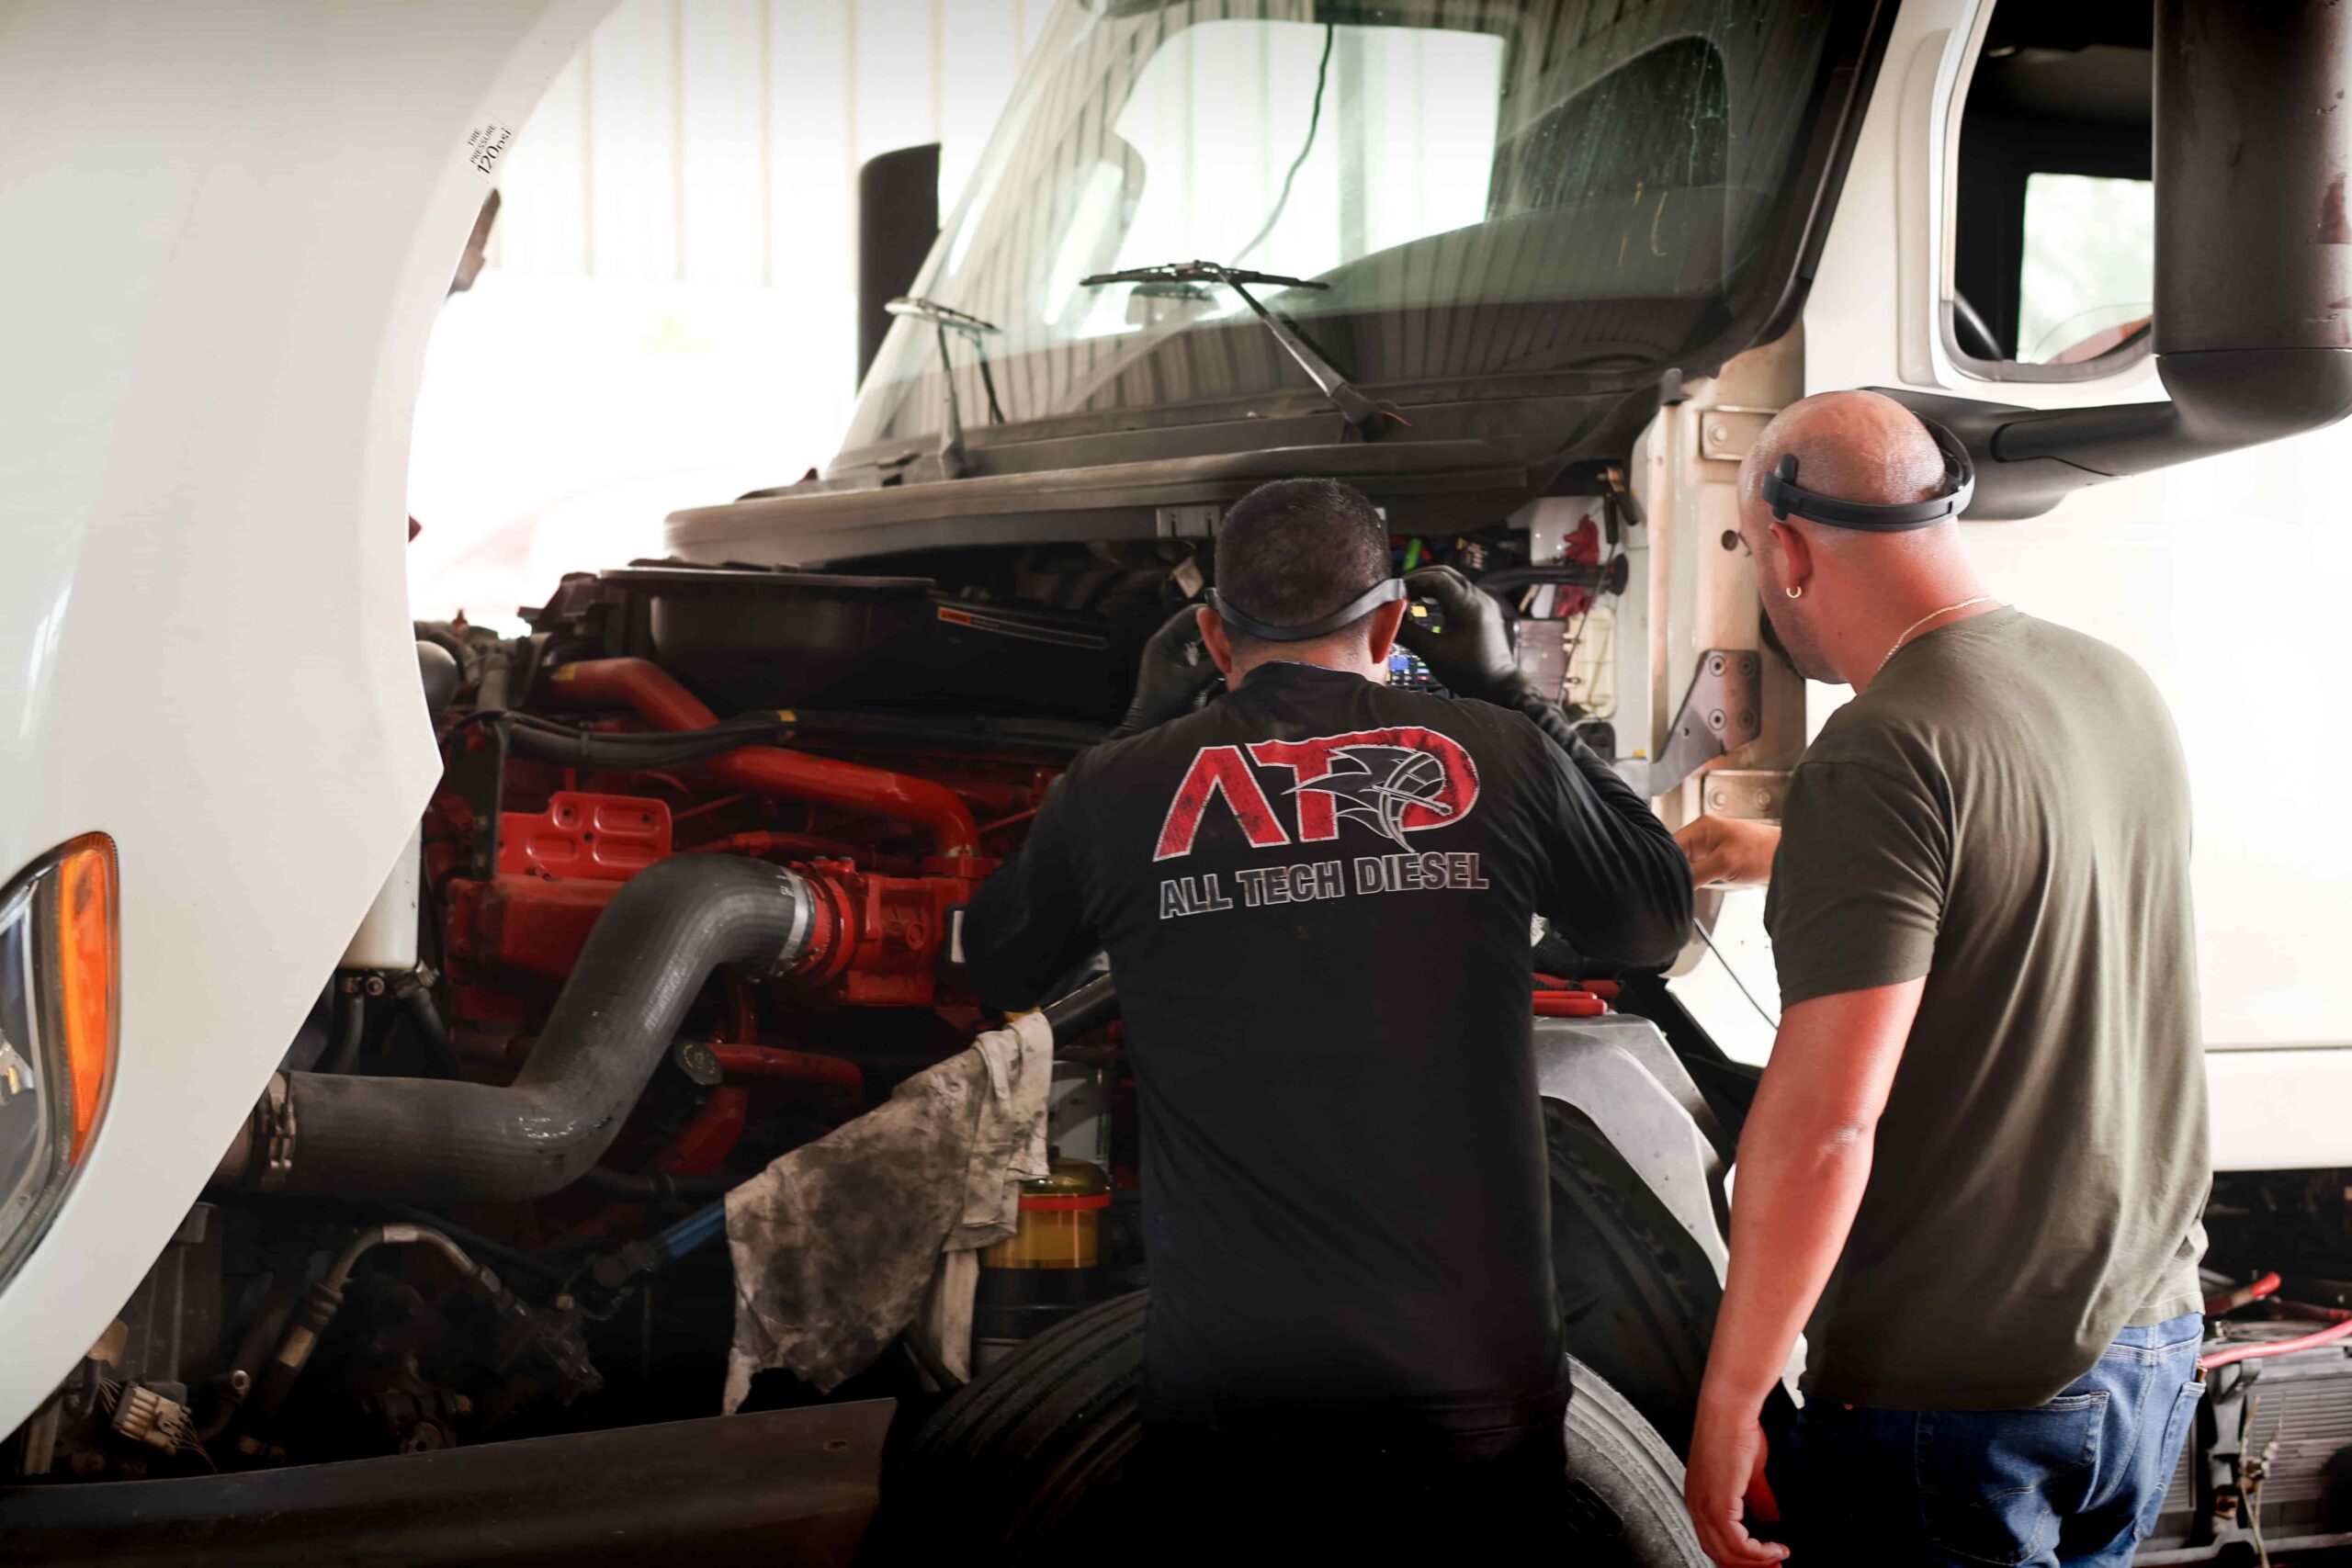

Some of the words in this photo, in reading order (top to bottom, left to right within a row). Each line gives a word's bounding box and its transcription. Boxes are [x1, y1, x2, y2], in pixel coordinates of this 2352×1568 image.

[467, 128, 481, 146] TIRE
[469, 123, 496, 164] PRESSURE
[478, 127, 512, 174] 120psi
[1159, 873, 1234, 919] ALL
[1235, 860, 1346, 908] TECH
[1353, 851, 1490, 896] DIESEL
